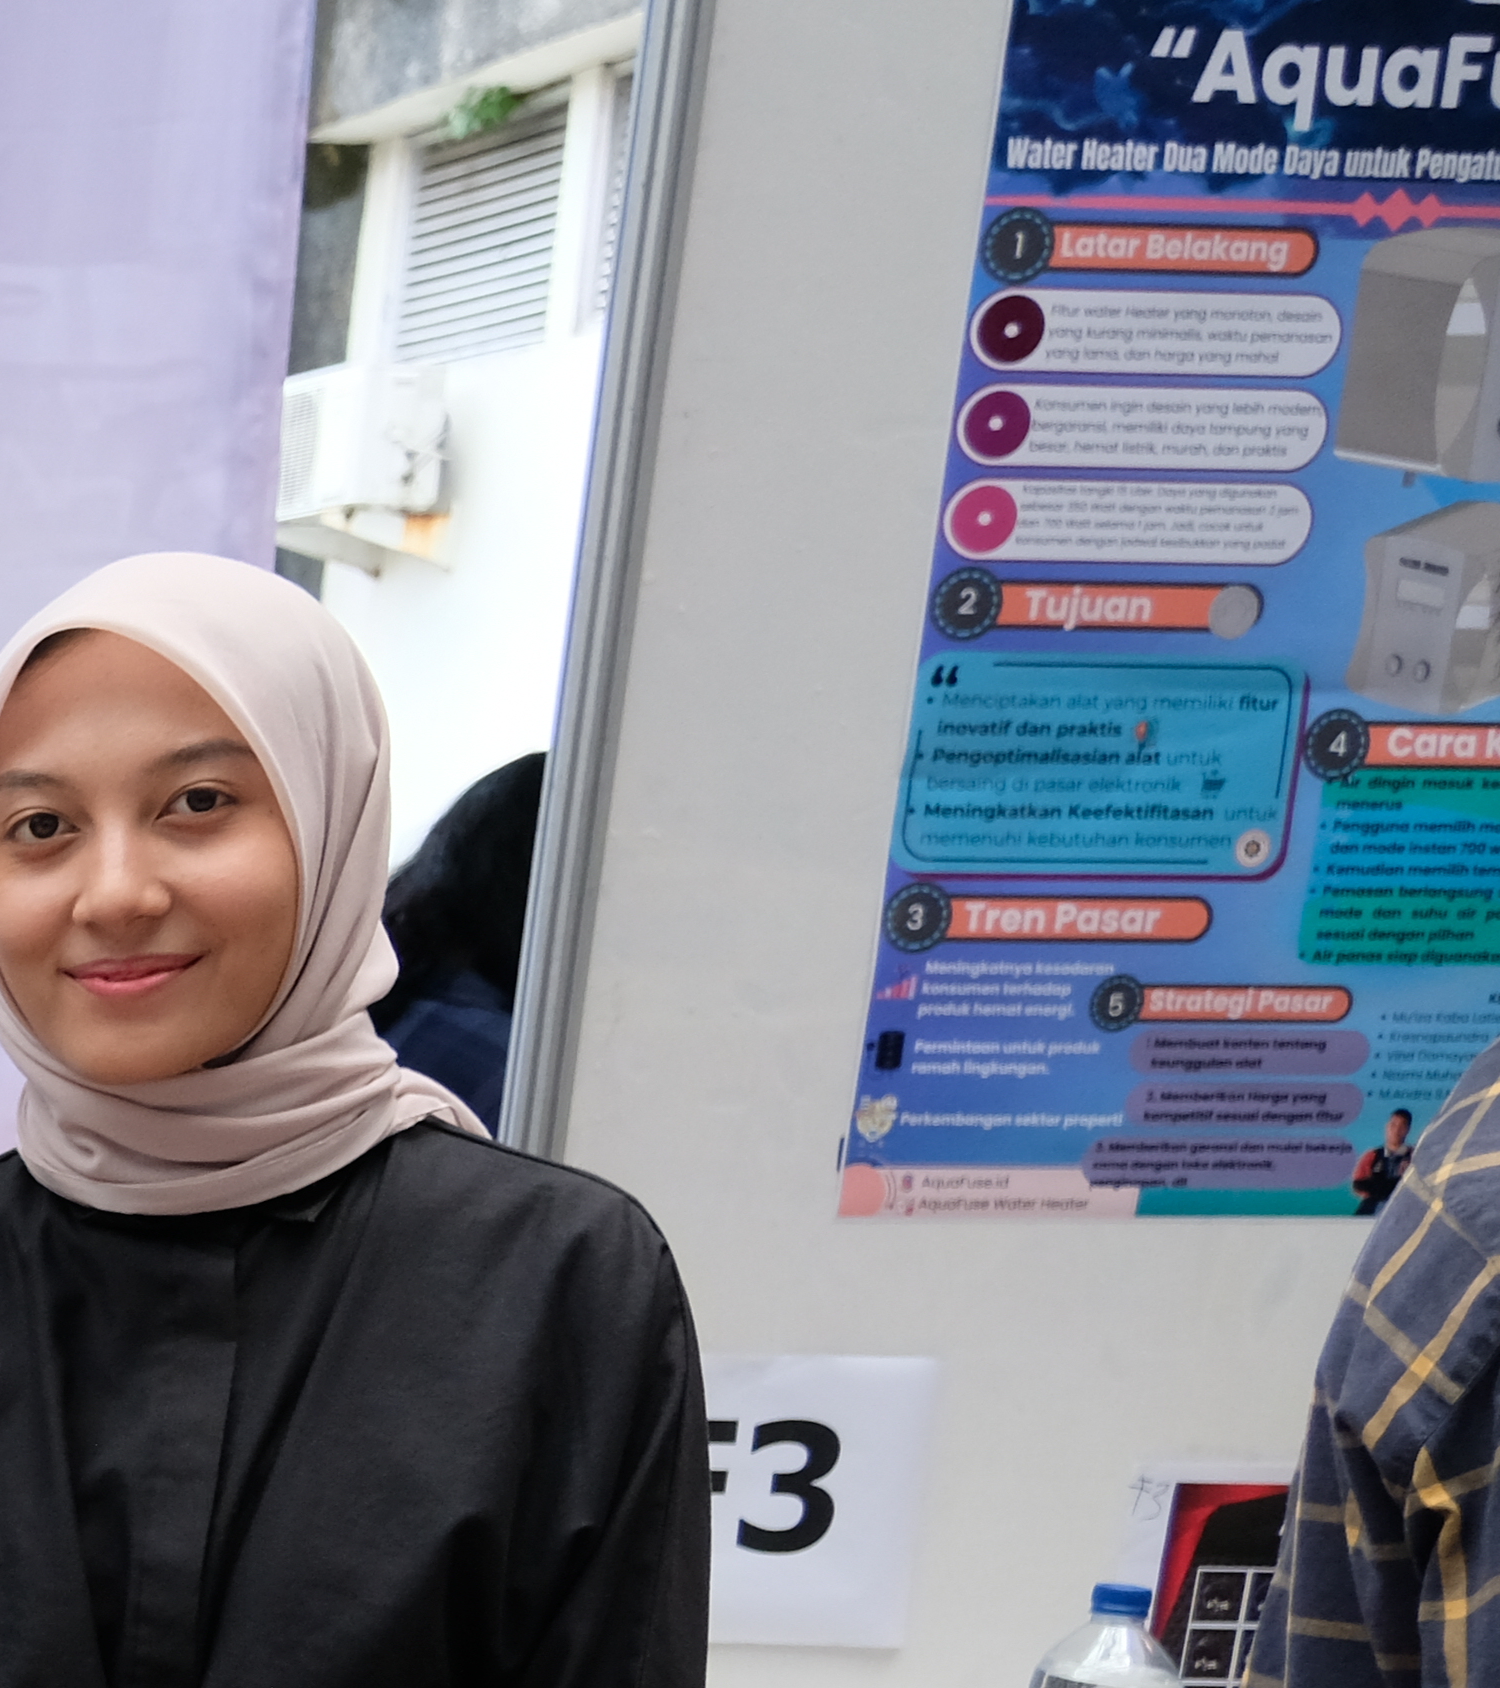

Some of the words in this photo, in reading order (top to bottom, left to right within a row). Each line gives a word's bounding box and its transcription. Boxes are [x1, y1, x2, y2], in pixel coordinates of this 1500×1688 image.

[1006, 136, 1078, 171] Water
[1080, 139, 1159, 173] Heater
[1162, 142, 1207, 173] Dua
[1211, 142, 1278, 175] Mode
[1283, 145, 1338, 180] Daya
[1344, 147, 1410, 179] untuk
[1013, 231, 1026, 259] 1
[1059, 232, 1140, 260] Latar
[1145, 233, 1291, 273] Belakang
[956, 587, 978, 615] 2
[1024, 588, 1154, 632] Tujuan
[1238, 695, 1280, 713] fitur
[937, 720, 1012, 737] inovatif
[1015, 721, 1051, 737] dan
[1055, 722, 1123, 740] praktis
[1329, 730, 1348, 757] 4
[1387, 726, 1477, 759] Cara
[1124, 750, 1162, 765] alat
[1166, 751, 1222, 767] untuk
[923, 803, 1063, 823] Meningkatkan
[1067, 805, 1214, 822] Keefektifitasan
[1223, 807, 1279, 823] untuk
[906, 902, 925, 931] 3
[965, 901, 1046, 933] Tren
[1053, 902, 1163, 934] Pasar
[1149, 987, 1253, 1021] Strategi
[1257, 990, 1333, 1014] Pasar
